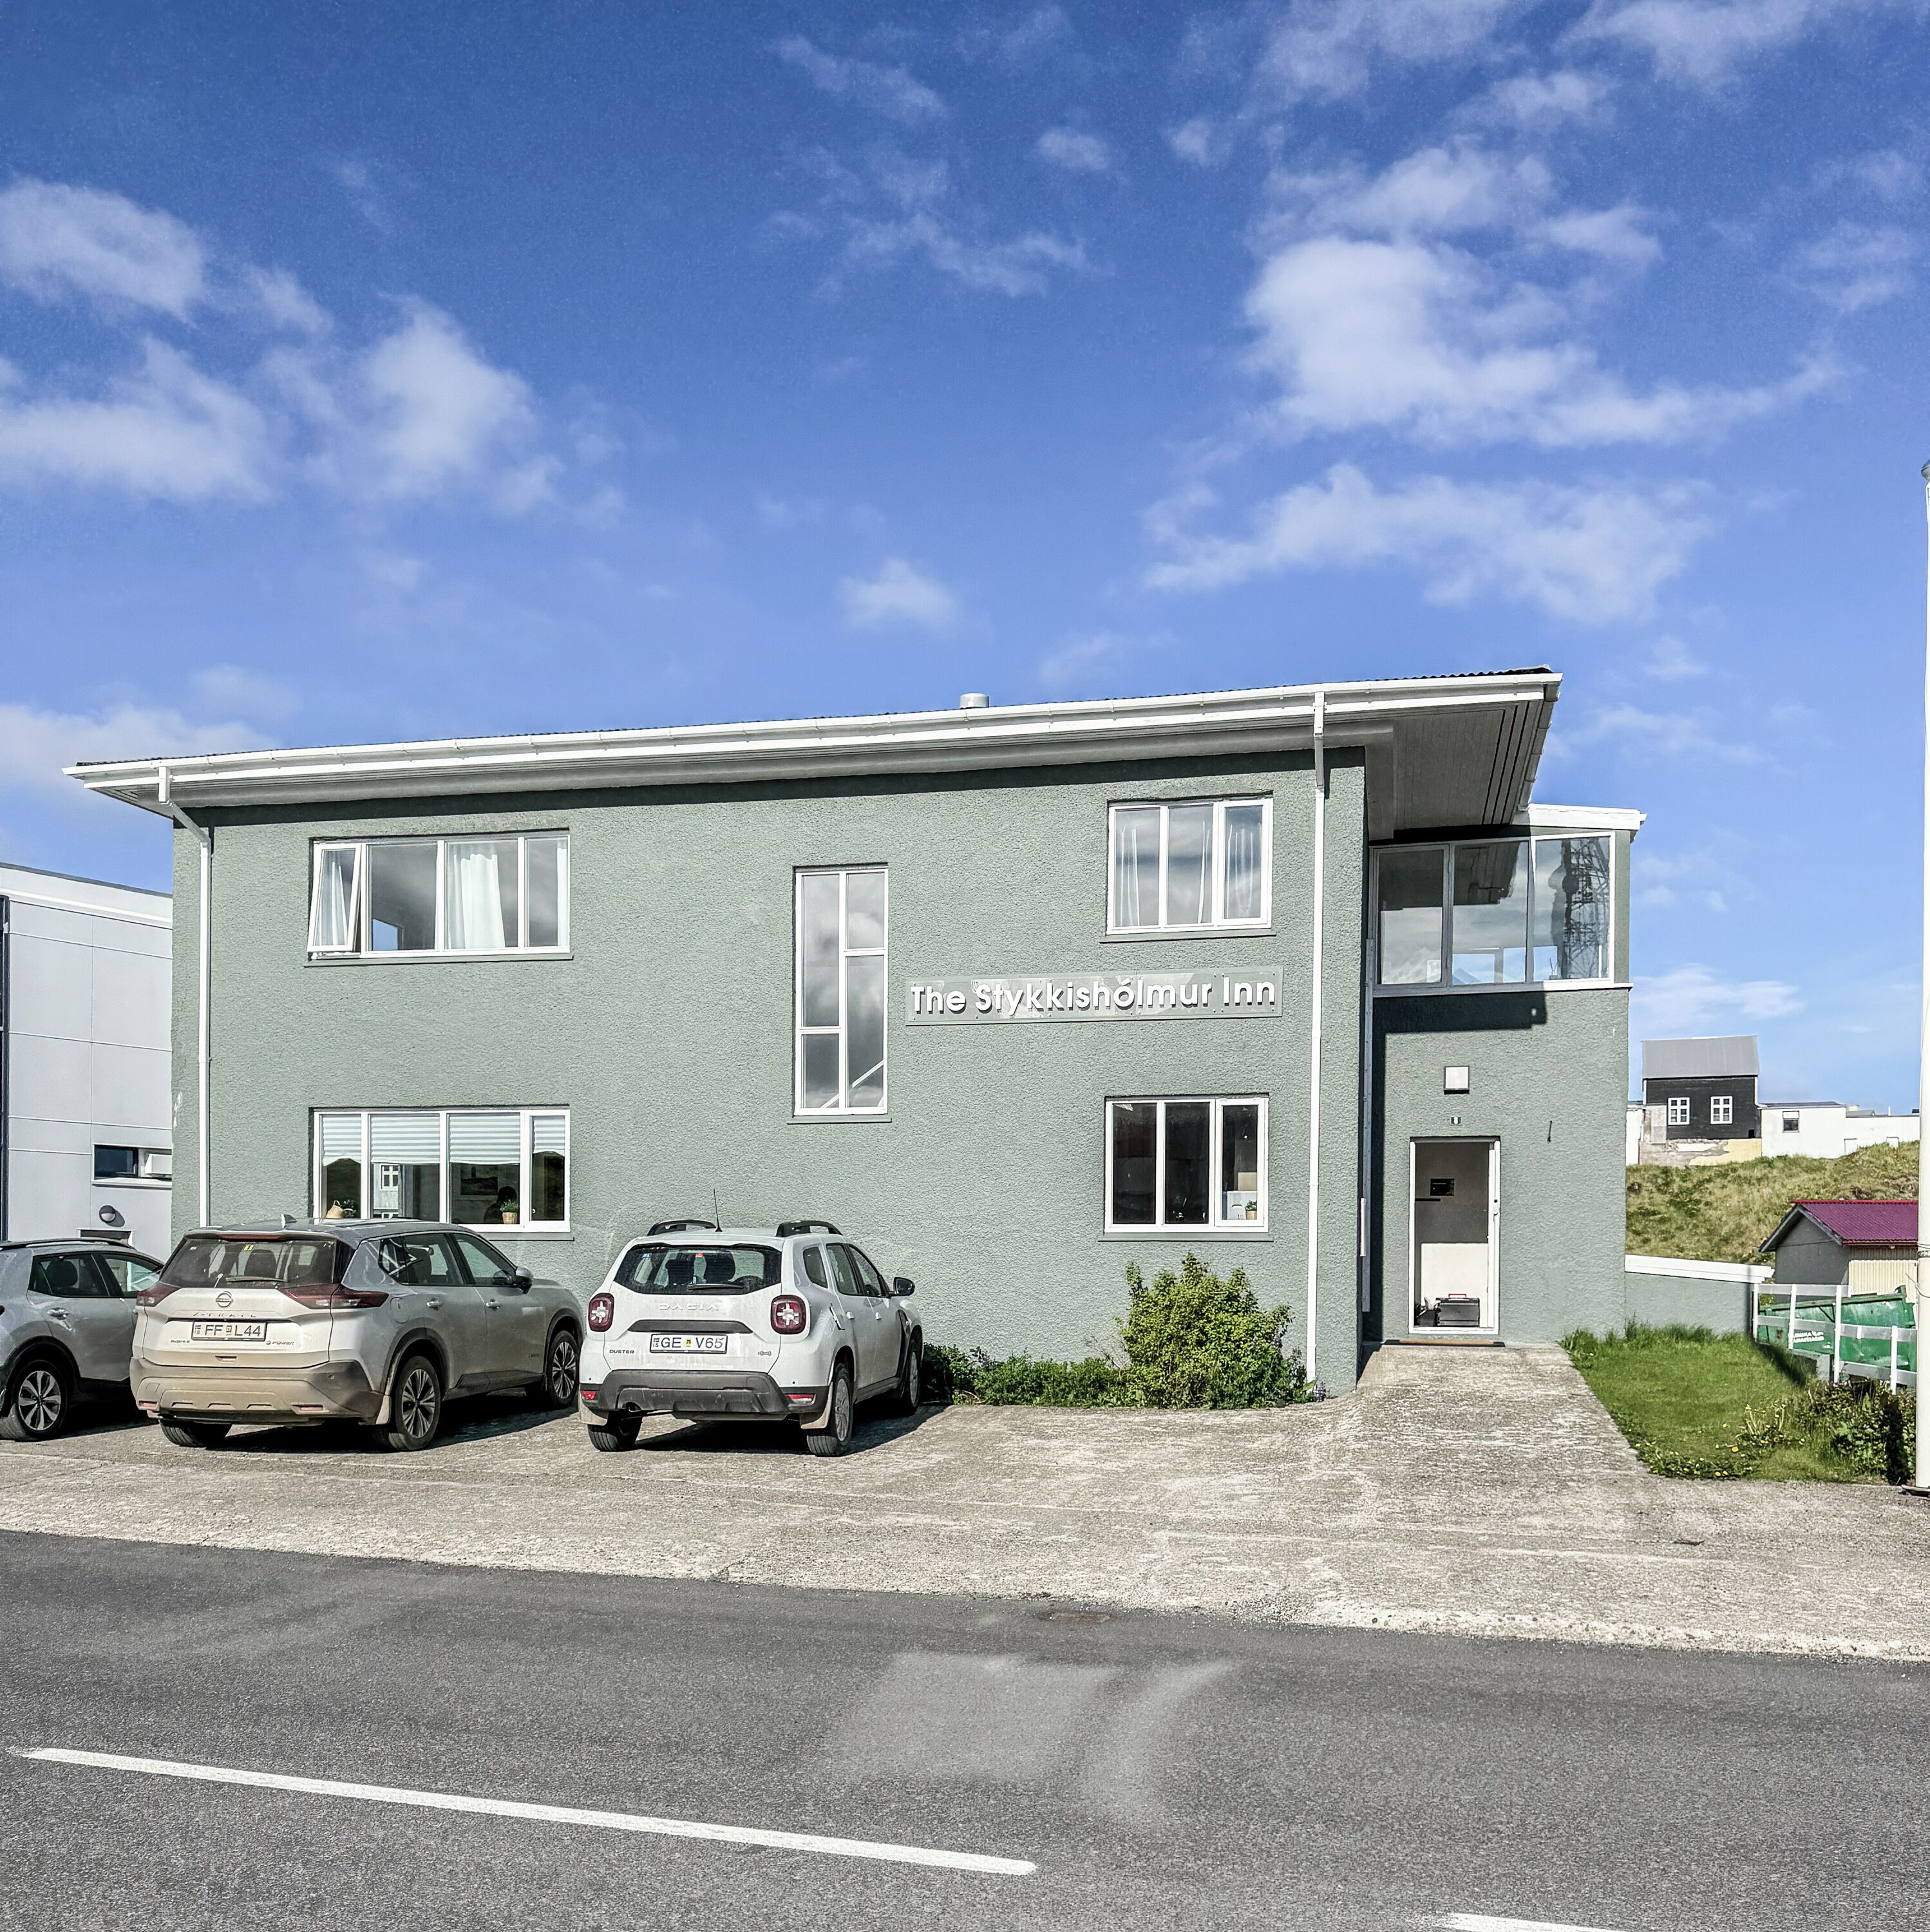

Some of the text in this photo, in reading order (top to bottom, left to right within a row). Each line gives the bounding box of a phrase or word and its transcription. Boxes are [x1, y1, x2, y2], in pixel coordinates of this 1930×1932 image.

[910, 976, 1276, 1016] The Stykkishólmur Inn
[659, 1303, 719, 1311] DACIA
[205, 1325, 223, 1336] FF
[234, 1325, 261, 1337] L44
[661, 1337, 724, 1349] GE V65
